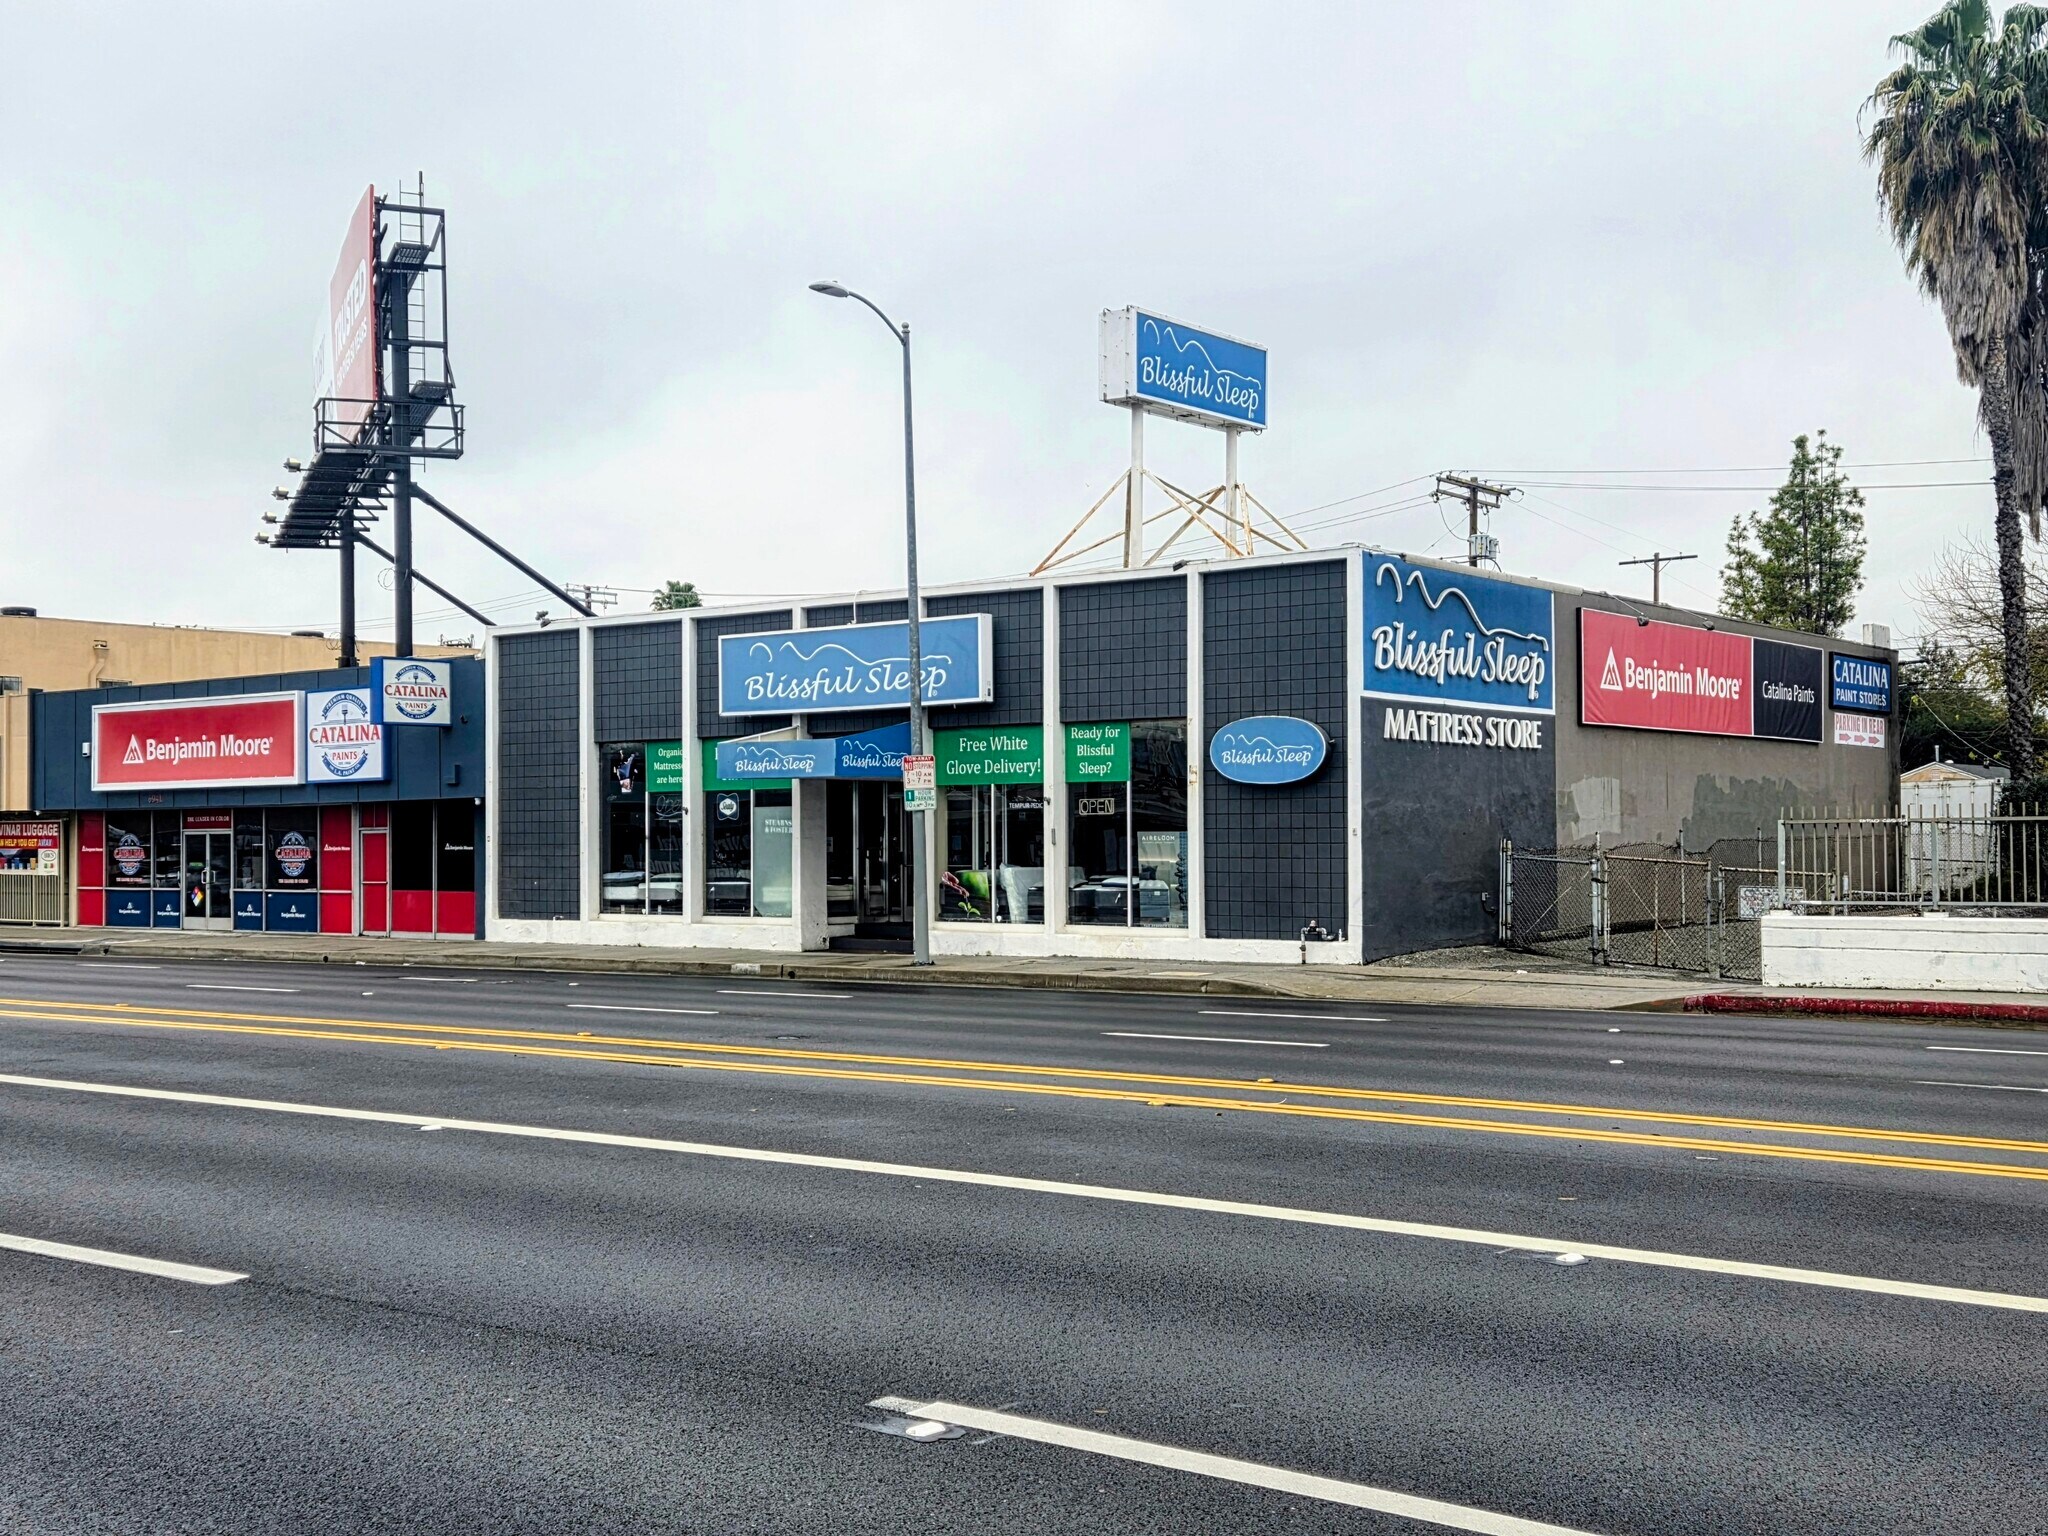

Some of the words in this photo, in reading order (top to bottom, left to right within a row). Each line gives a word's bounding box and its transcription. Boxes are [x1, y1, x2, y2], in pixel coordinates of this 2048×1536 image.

[335, 258, 366, 361] TRUSTED
[1140, 355, 1214, 398] Blissful
[1214, 375, 1259, 418] Sleep
[1372, 621, 1482, 685] Blissful
[1482, 636, 1545, 700] Sleep
[744, 666, 862, 700] Blissful
[1624, 657, 1692, 700] Benjamin
[1696, 666, 1740, 700] Moore
[1834, 660, 1888, 690] CATALINA
[384, 684, 448, 698] CATALINA
[1762, 680, 1792, 701] Catalina
[1794, 684, 1814, 704] Paints
[1836, 688, 1857, 702] PAINT
[1859, 691, 1886, 706] STORES
[326, 694, 345, 709] PREMIUM
[1071, 726, 1102, 740] Ready
[1105, 726, 1120, 738] for
[1384, 707, 1482, 746] MATTRESS
[1486, 717, 1542, 748] STORE
[1836, 714, 1860, 733] PARKING
[1861, 716, 1868, 734] IN
[1868, 718, 1884, 735] REAR
[310, 724, 380, 743] CATALINA
[146, 735, 216, 765] Benjamin
[220, 734, 270, 757] Moore
[960, 738, 987, 752] Free
[990, 736, 1028, 751] White
[1077, 744, 1114, 756] Blissful
[332, 750, 358, 760] PAINTS
[842, 754, 881, 769] Blissful
[882, 754, 904, 770] Slee
[1222, 748, 1275, 765] Blissful
[1276, 748, 1311, 766] Sleep
[654, 762, 682, 770] Mattress
[735, 758, 781, 773] Blissful
[782, 756, 813, 772] Sleep
[946, 760, 981, 775] Glove
[984, 758, 1041, 777] Delivery!
[1079, 762, 1112, 776] Sleep?
[908, 792, 912, 800] 1
[1080, 800, 1113, 814] OPEN
[22, 824, 58, 836] LUGGAGE
[38, 838, 52, 846] AWAY
